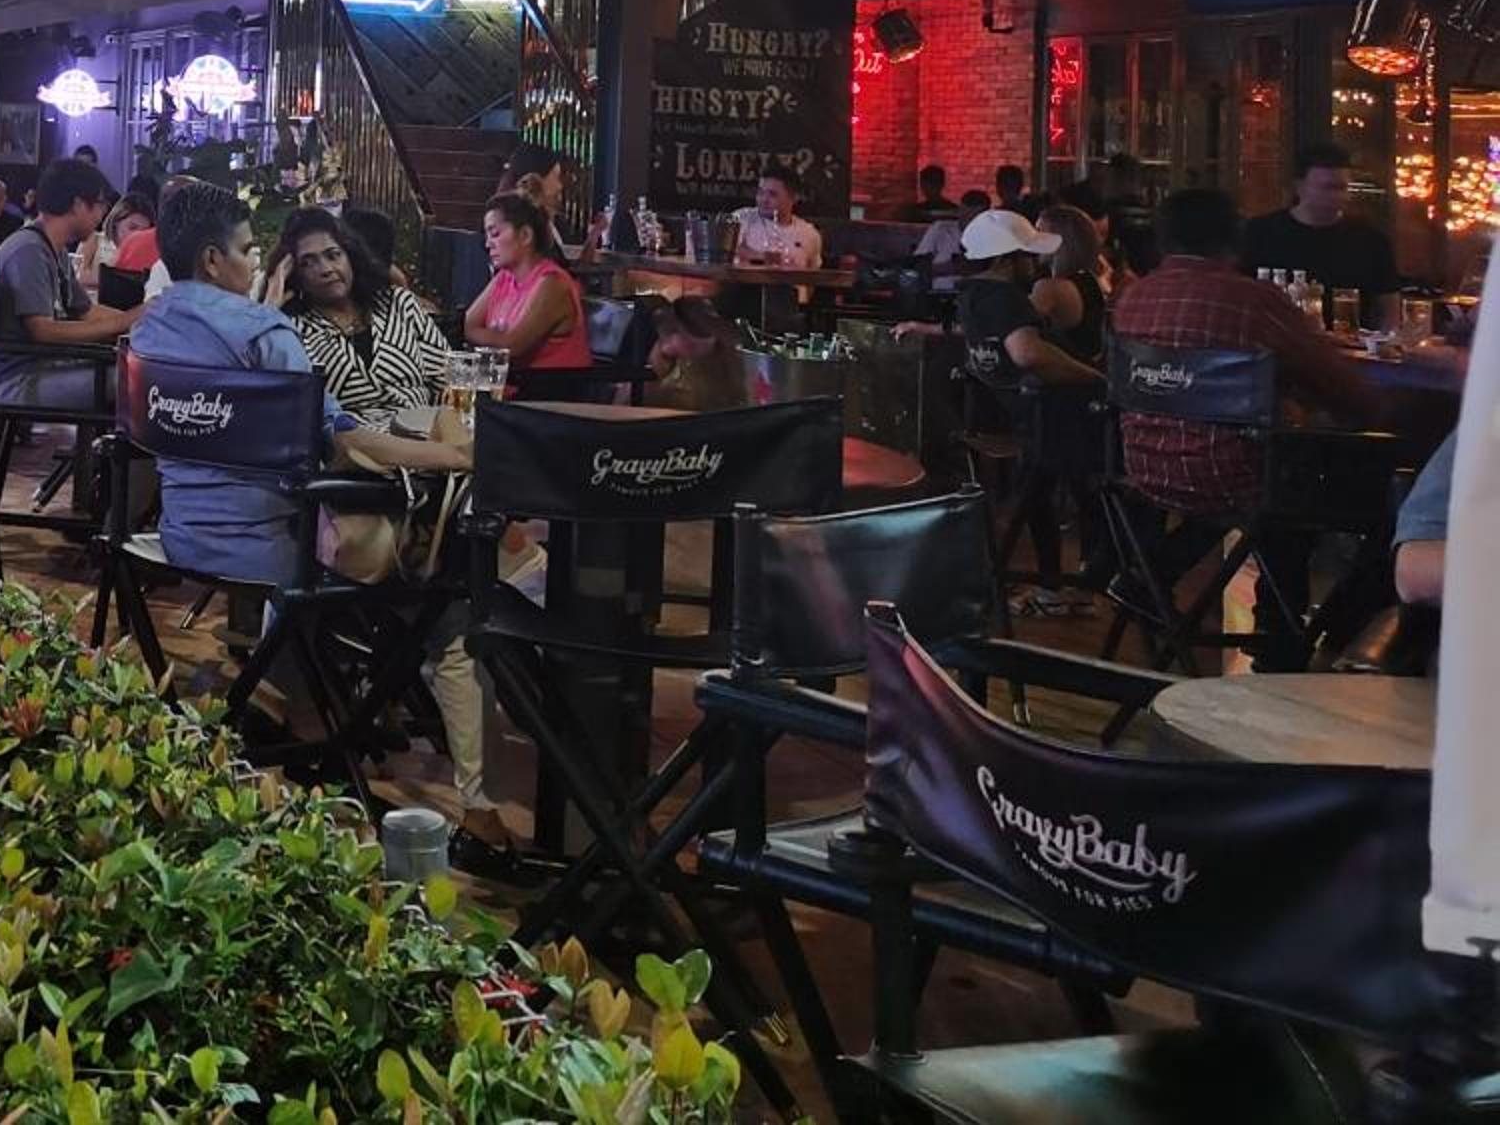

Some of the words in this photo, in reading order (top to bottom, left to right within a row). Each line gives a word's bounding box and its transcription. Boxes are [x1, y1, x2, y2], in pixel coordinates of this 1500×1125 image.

[706, 22, 830, 58] HUNGRY?
[652, 84, 781, 119] HIRSTY?
[147, 385, 235, 428] GravyBaby
[591, 444, 723, 485] GravyBaby
[977, 765, 1198, 904] GravyBaby
